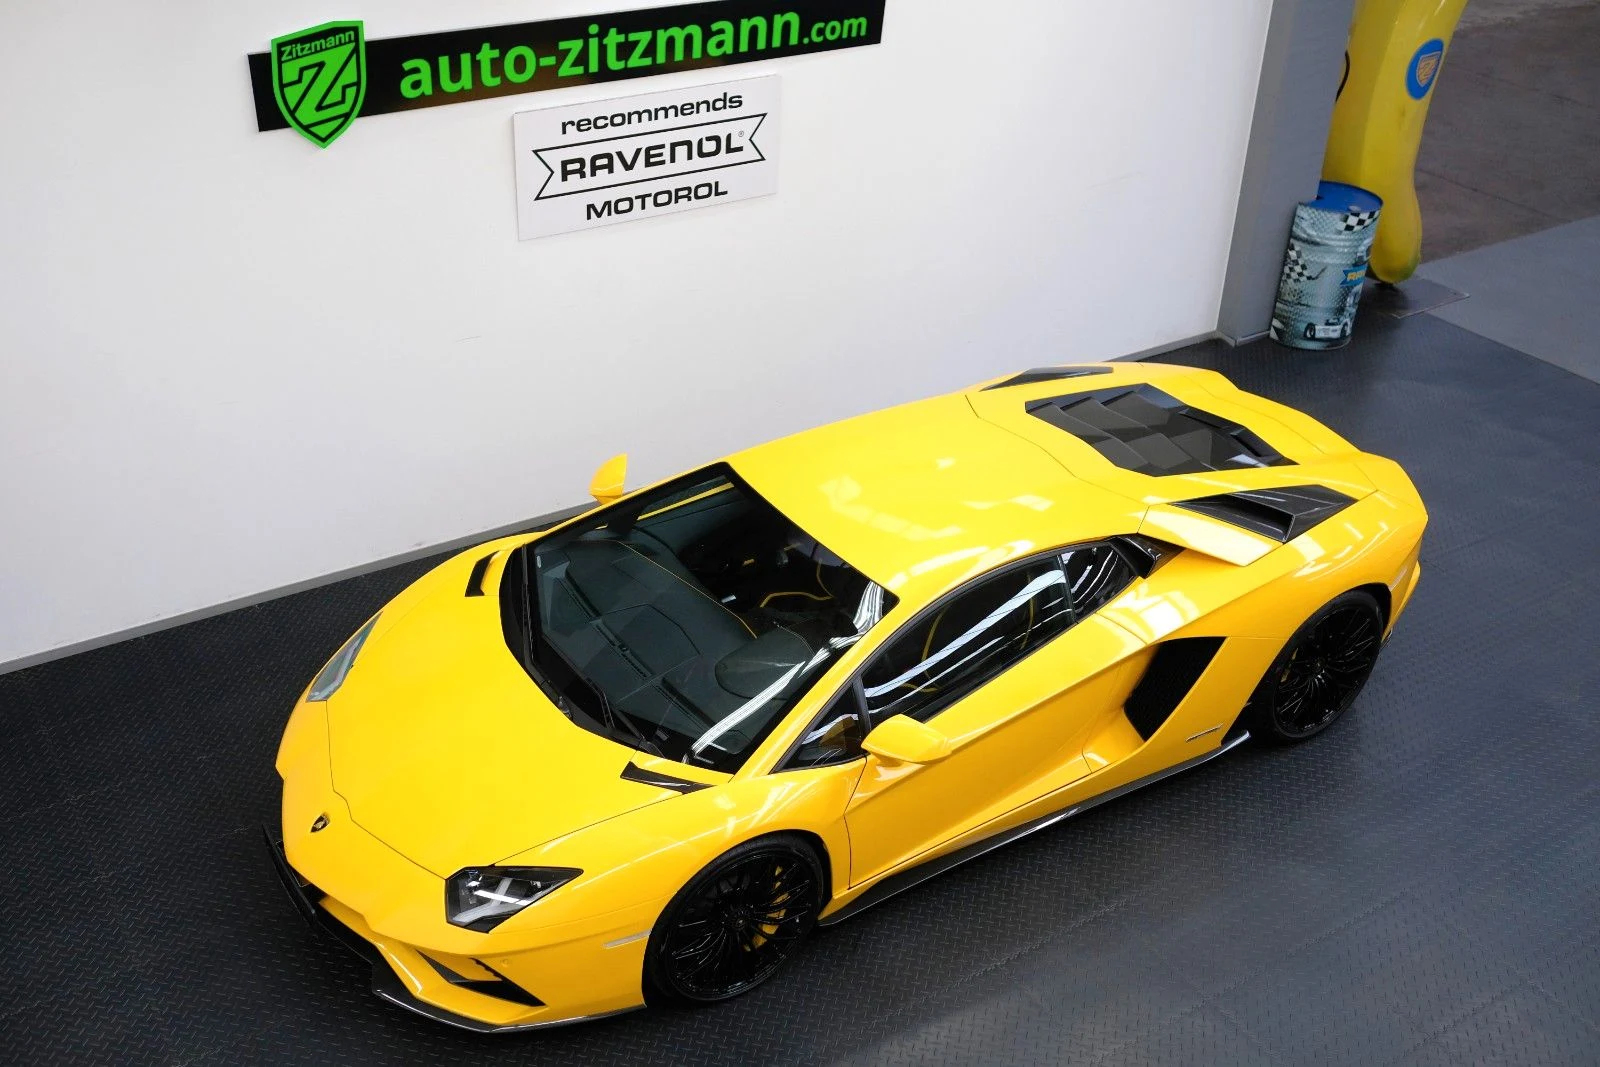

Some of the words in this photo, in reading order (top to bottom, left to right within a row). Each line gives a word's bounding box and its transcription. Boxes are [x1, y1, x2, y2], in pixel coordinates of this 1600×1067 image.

[280, 30, 356, 62] Zitzmann
[400, 12, 867, 99] auto-zitzmann.com
[561, 92, 743, 135] recommends
[586, 180, 728, 221] MOTOROL
